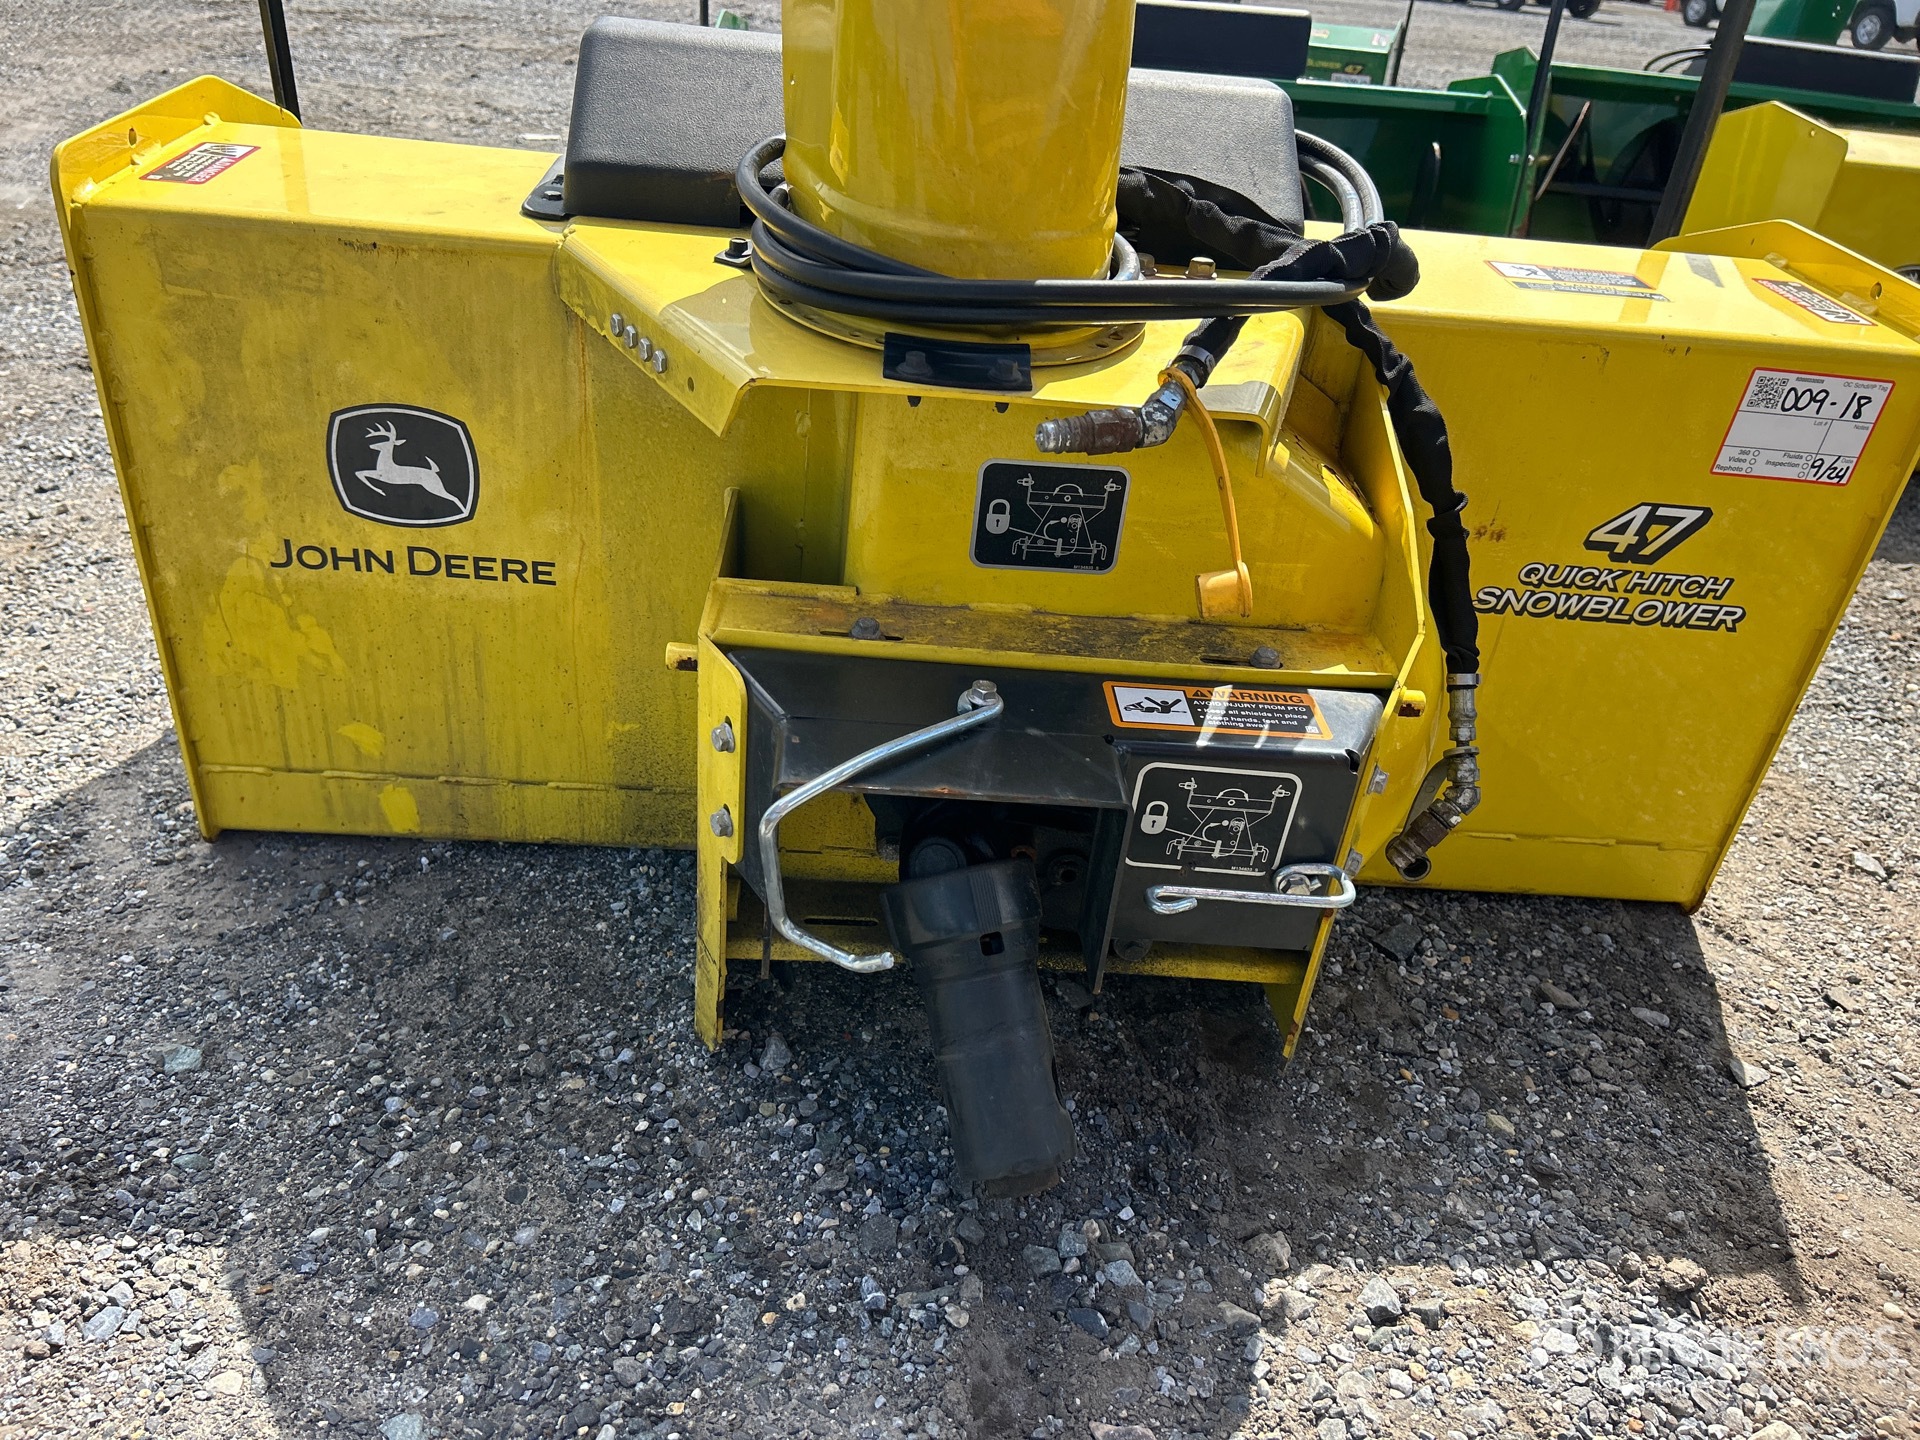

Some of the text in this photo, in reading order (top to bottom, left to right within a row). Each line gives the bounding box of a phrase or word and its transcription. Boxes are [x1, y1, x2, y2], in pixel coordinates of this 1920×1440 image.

[1728, 456, 1747, 464] Video
[1782, 452, 1803, 460] Fluids
[1715, 464, 1743, 472] Rephoto
[1765, 460, 1800, 468] Inspection
[1811, 456, 1850, 483] 9/24
[1584, 502, 1713, 565] 47
[270, 538, 557, 586] JOHN DEERE
[1519, 563, 1734, 599] QUICK HITCH
[1472, 586, 1746, 632] SNOWBLOWER
[1208, 690, 1305, 704] WARNING
[1208, 720, 1244, 728] clothing
